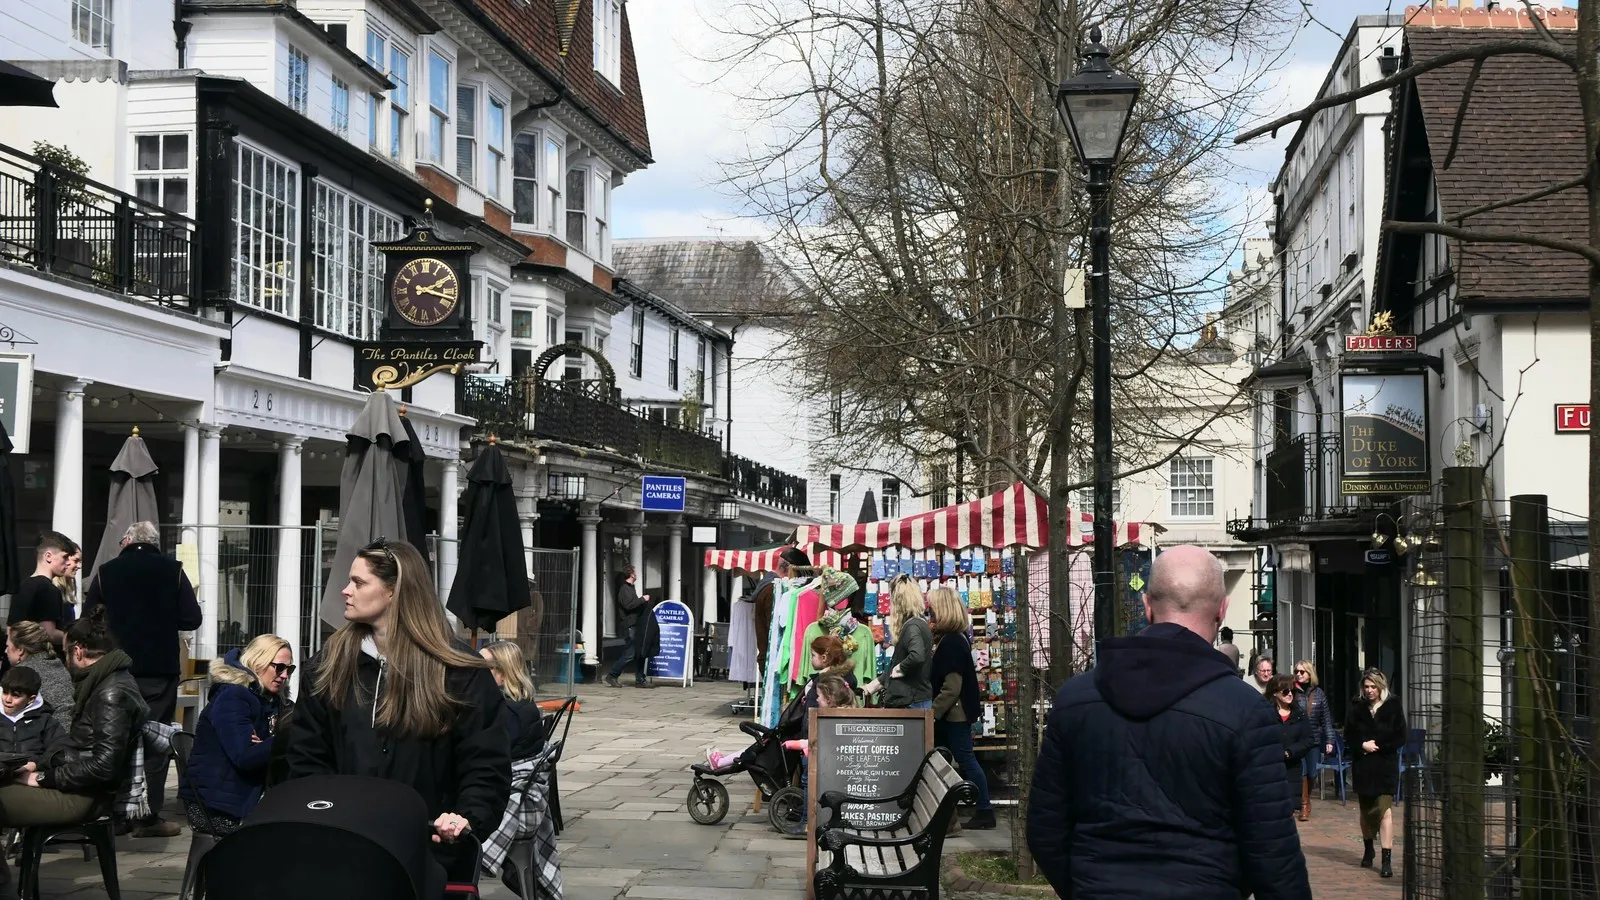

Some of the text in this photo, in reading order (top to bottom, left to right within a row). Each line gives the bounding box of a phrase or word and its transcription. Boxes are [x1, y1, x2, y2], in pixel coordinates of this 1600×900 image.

[1349, 336, 1412, 349] FULLER'S
[362, 348, 475, 360] The Pantiles Clock
[1350, 425, 1375, 437] THE
[1352, 438, 1397, 452] DUKE
[1376, 453, 1418, 467] YORK
[645, 483, 682, 492] PANTILES
[1345, 483, 1428, 491] DINING AREA UPSTAIRS
[646, 491, 681, 500] CAMERAS
[840, 745, 900, 755] PERFECT COFFEES
[840, 754, 891, 763] FINE LEAF TEAS
[847, 784, 878, 793] BAGELS
